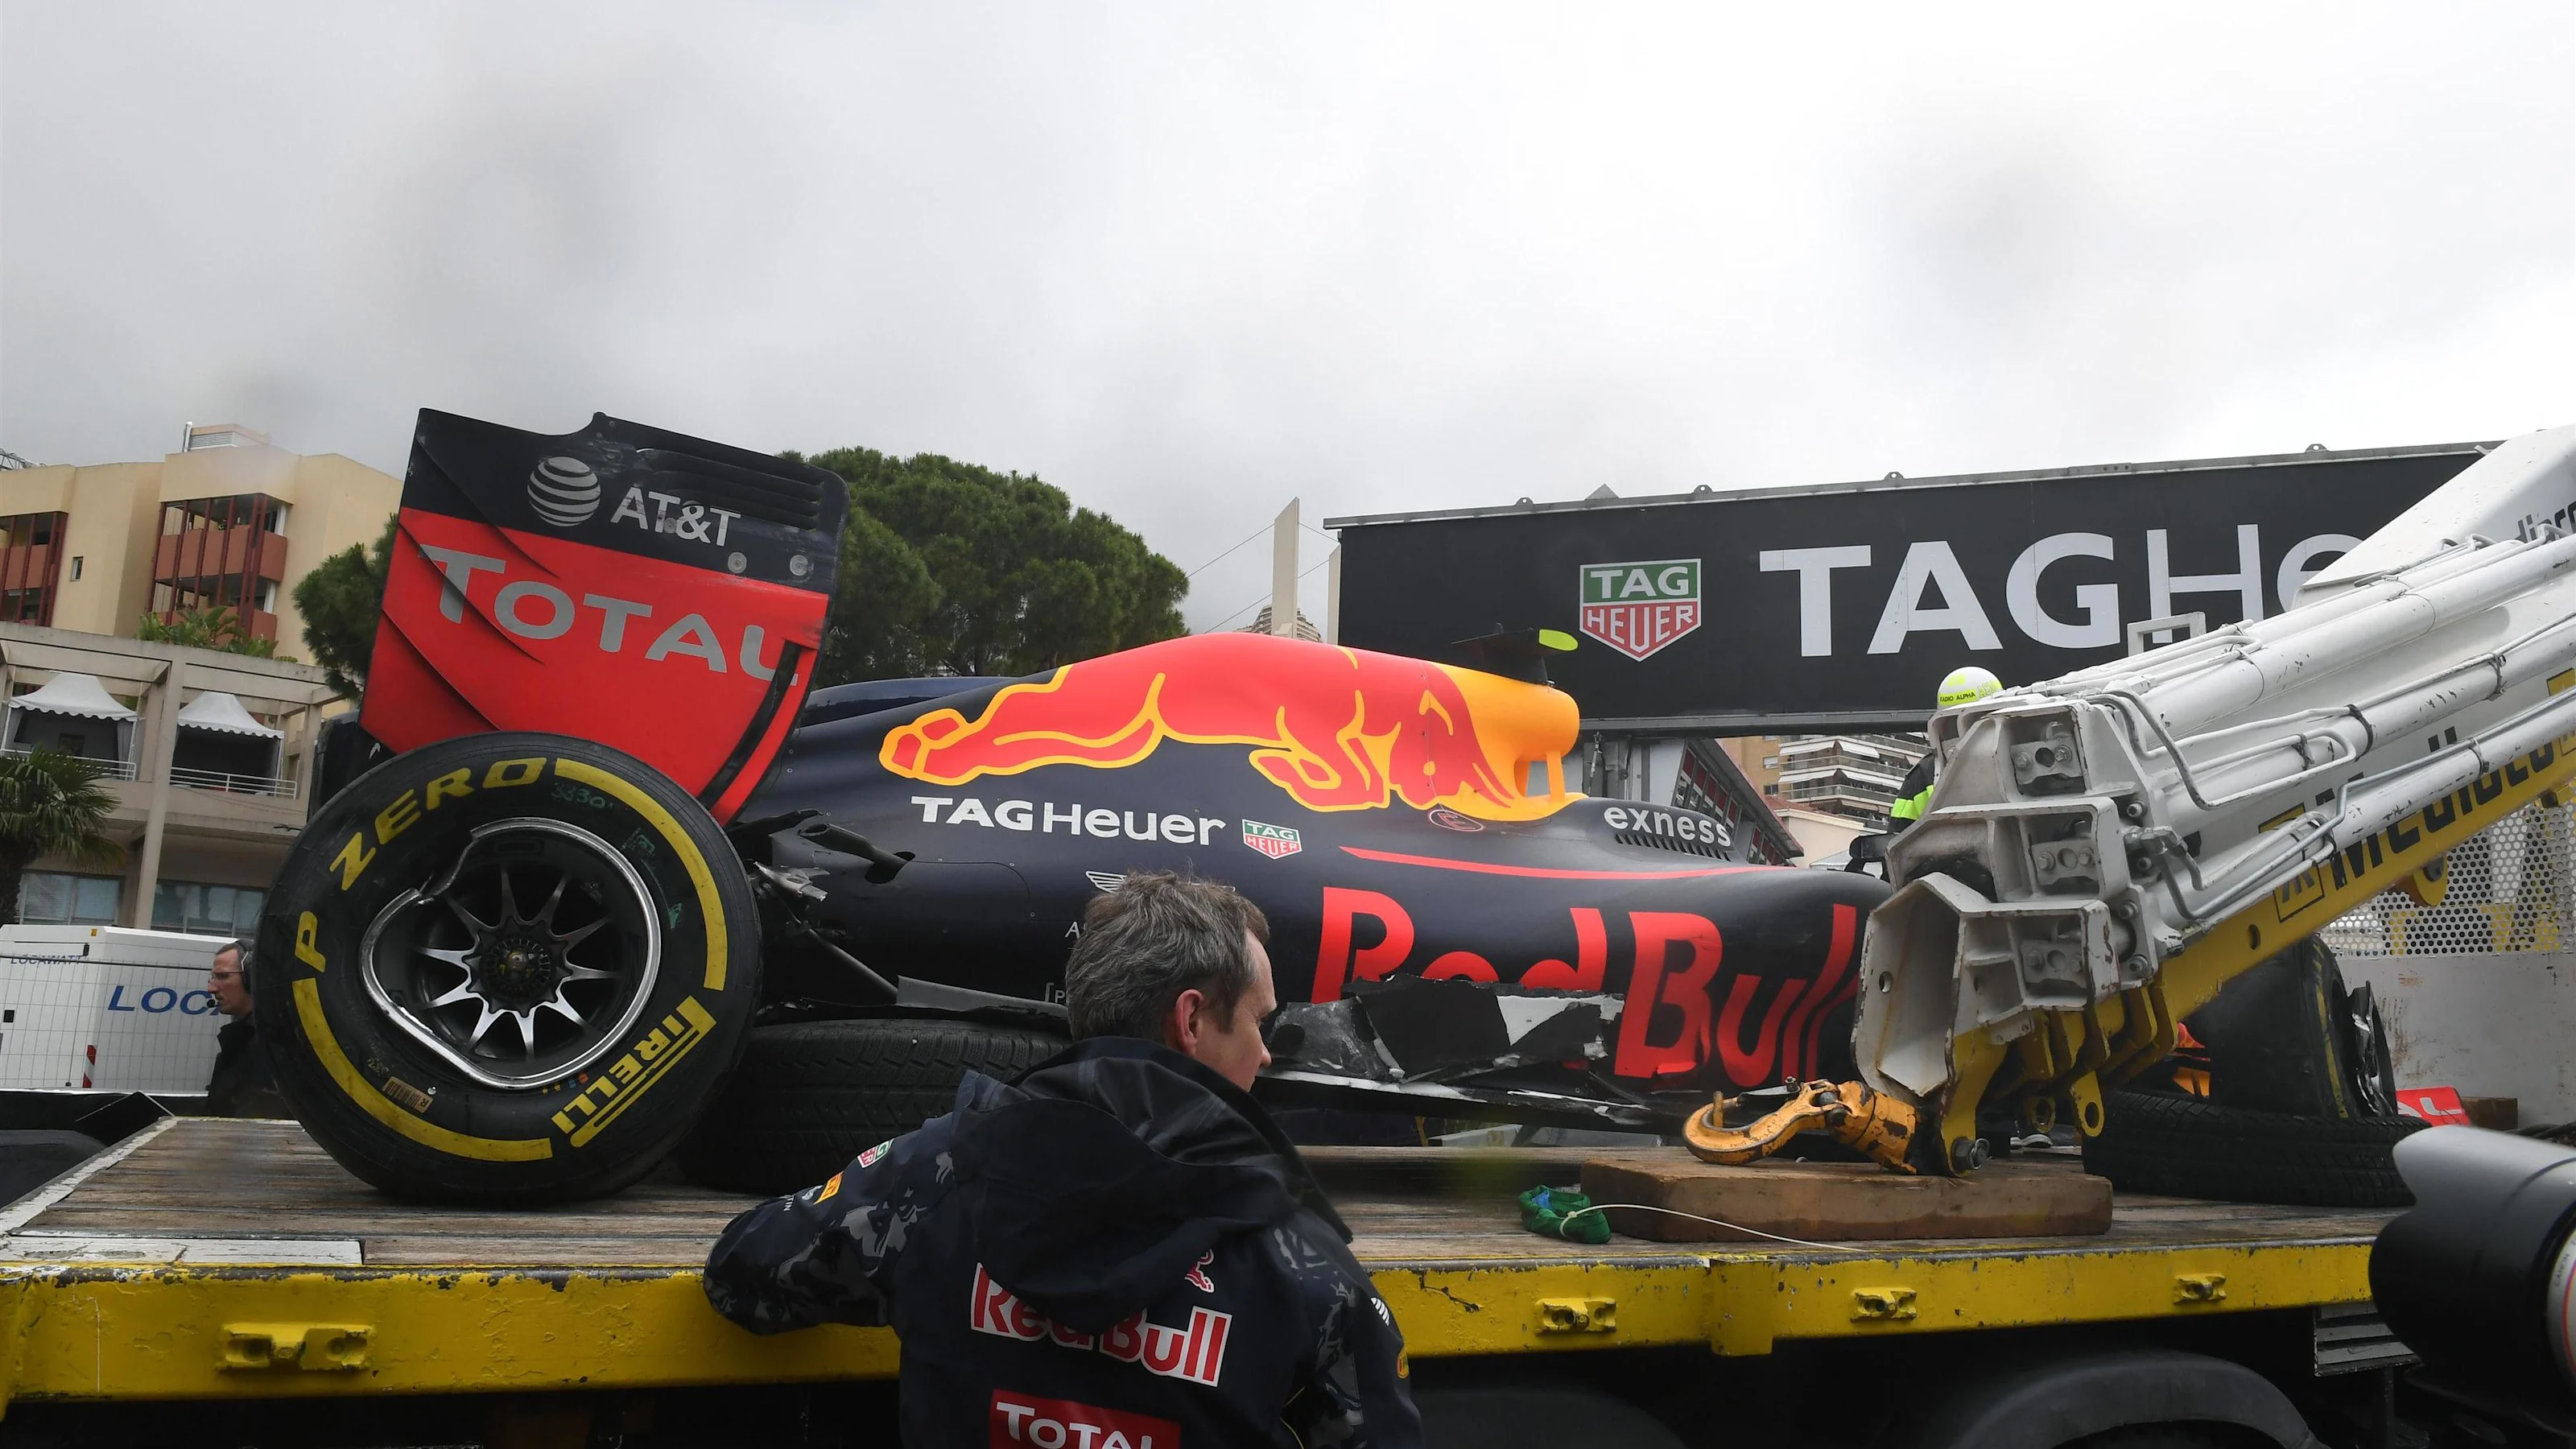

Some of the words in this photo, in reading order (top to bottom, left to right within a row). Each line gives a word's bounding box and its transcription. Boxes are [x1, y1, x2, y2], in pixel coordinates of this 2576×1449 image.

[610, 486, 741, 547] AT&T
[1590, 564, 1691, 600] TAG
[419, 543, 799, 687] TOTAL
[1586, 605, 1695, 653] HEUER
[1955, 691, 1976, 701] ALPHA
[1246, 822, 1294, 840] TAG
[1247, 836, 1298, 856] HEUER
[1604, 807, 1732, 848] exness
[295, 910, 325, 972] P
[330, 758, 547, 890] ZERO
[107, 985, 224, 1016] LOC
[551, 996, 716, 1148] PIRELLI
